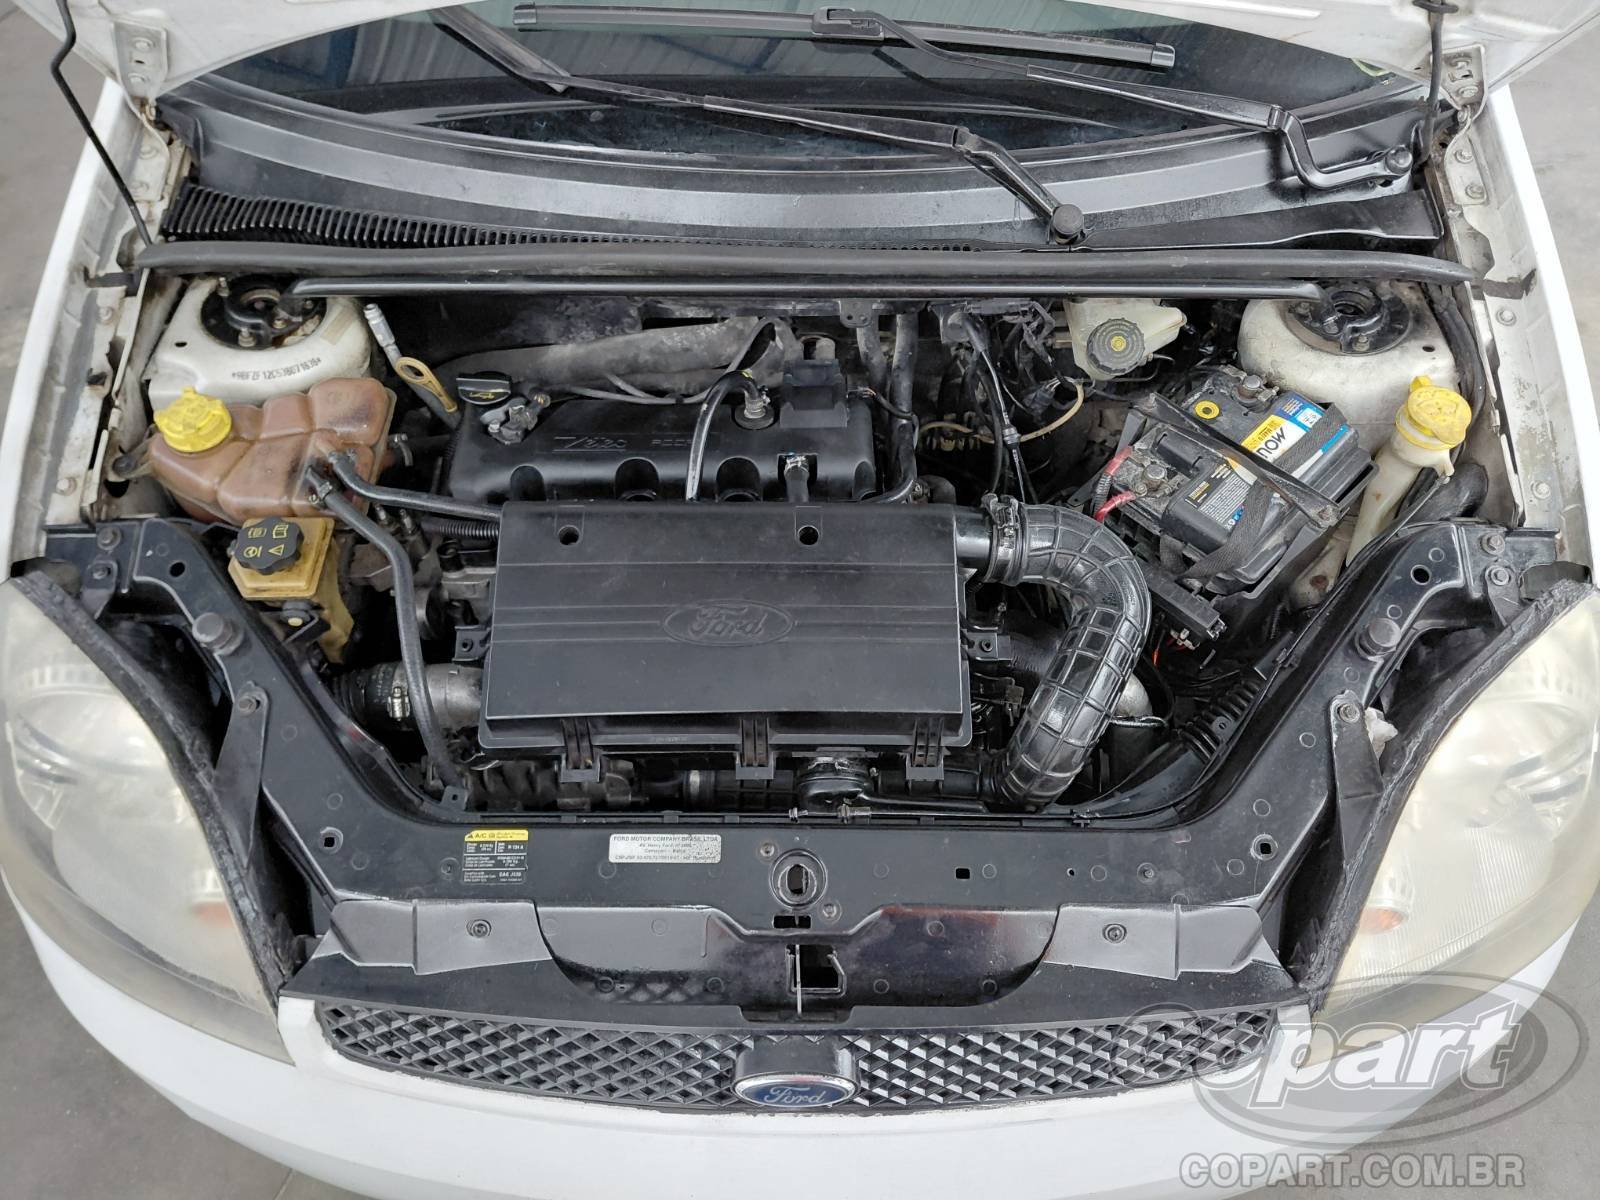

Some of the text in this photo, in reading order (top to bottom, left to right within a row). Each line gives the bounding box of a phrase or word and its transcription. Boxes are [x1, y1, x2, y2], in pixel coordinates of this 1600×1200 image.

[1256, 426, 1286, 459] MOU
[688, 605, 769, 639] Ford
[764, 1086, 826, 1104] Ford
